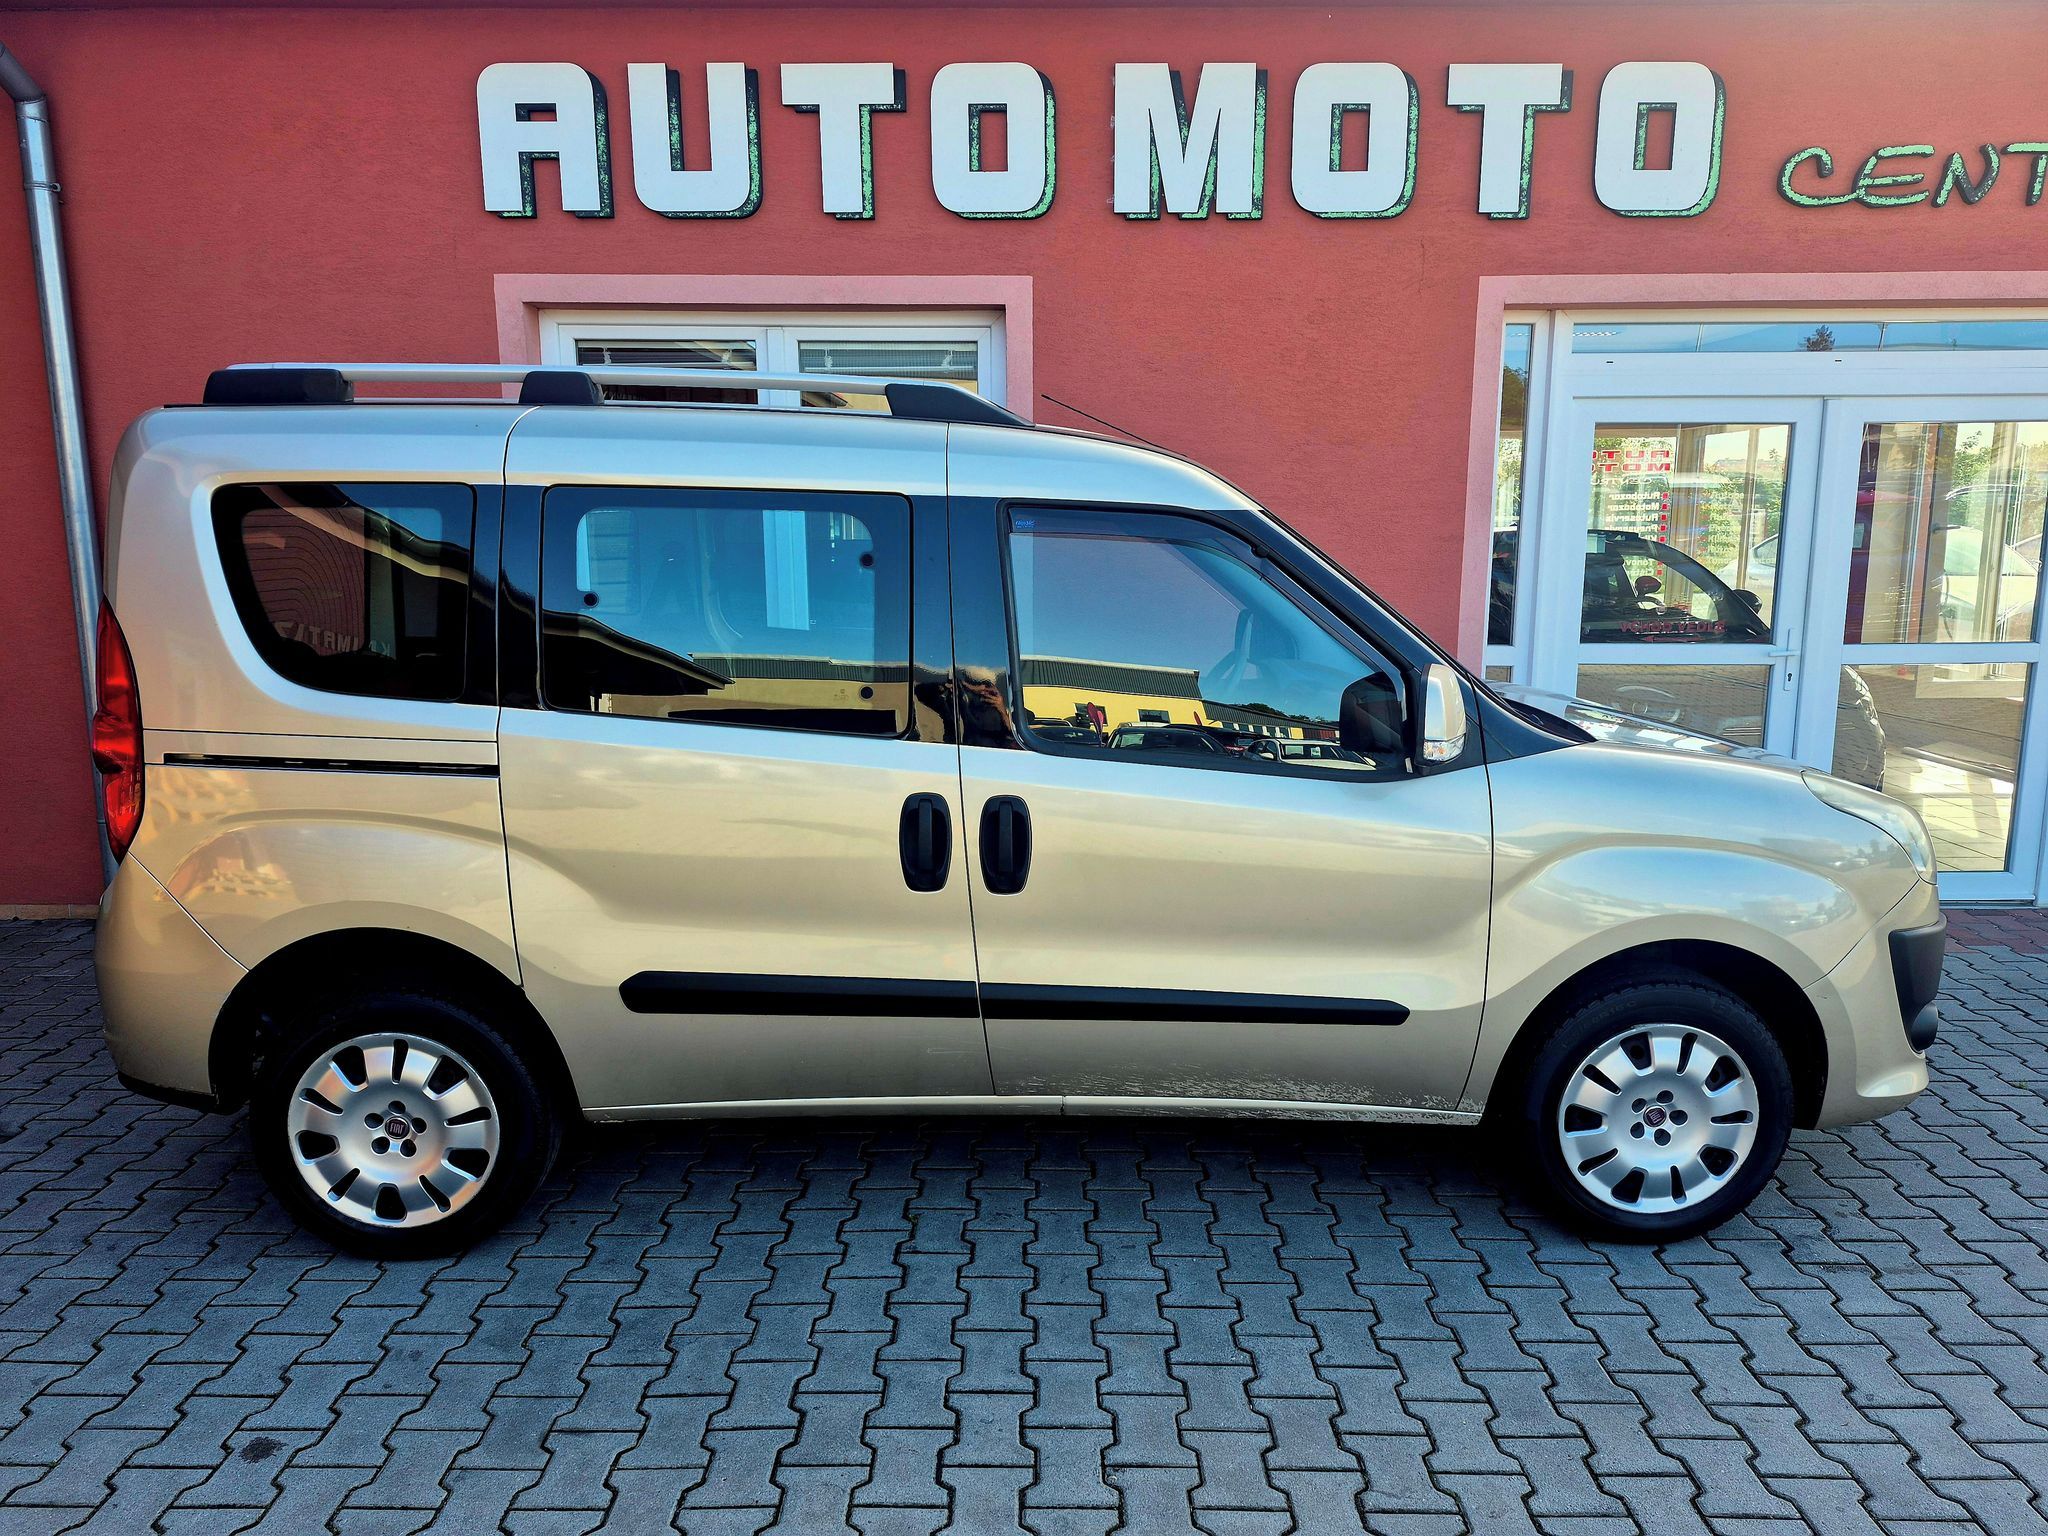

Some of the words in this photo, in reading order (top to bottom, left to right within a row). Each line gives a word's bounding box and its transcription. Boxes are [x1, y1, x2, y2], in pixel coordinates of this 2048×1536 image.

[476, 61, 1056, 220] AUTO
[1112, 61, 1726, 220] MOTO
[1776, 142, 2048, 207] CENT
[389, 1122, 404, 1135] FIAT
